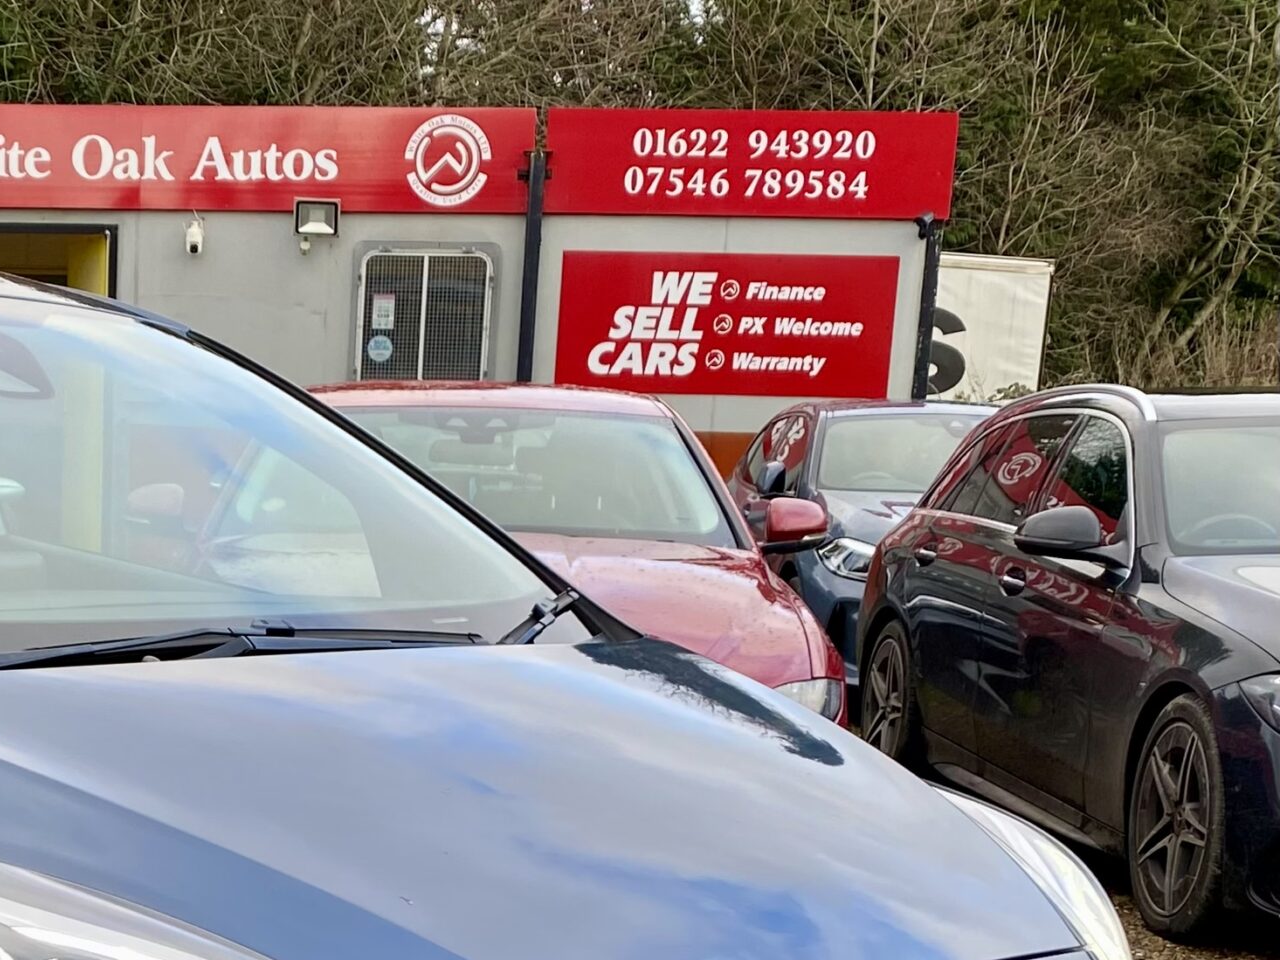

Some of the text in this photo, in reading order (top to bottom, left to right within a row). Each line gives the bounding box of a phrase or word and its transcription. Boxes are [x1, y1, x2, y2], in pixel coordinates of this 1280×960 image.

[71, 134, 175, 180] Oak
[189, 136, 339, 181] Autos
[632, 128, 876, 159] 01622 943920
[623, 166, 869, 199] 07546 789584
[651, 271, 719, 305] WE
[745, 281, 826, 301] Finance
[608, 305, 704, 340] SELL
[737, 316, 864, 336] PX Welcome
[587, 341, 700, 376] CARS
[732, 352, 827, 377] Warranty
